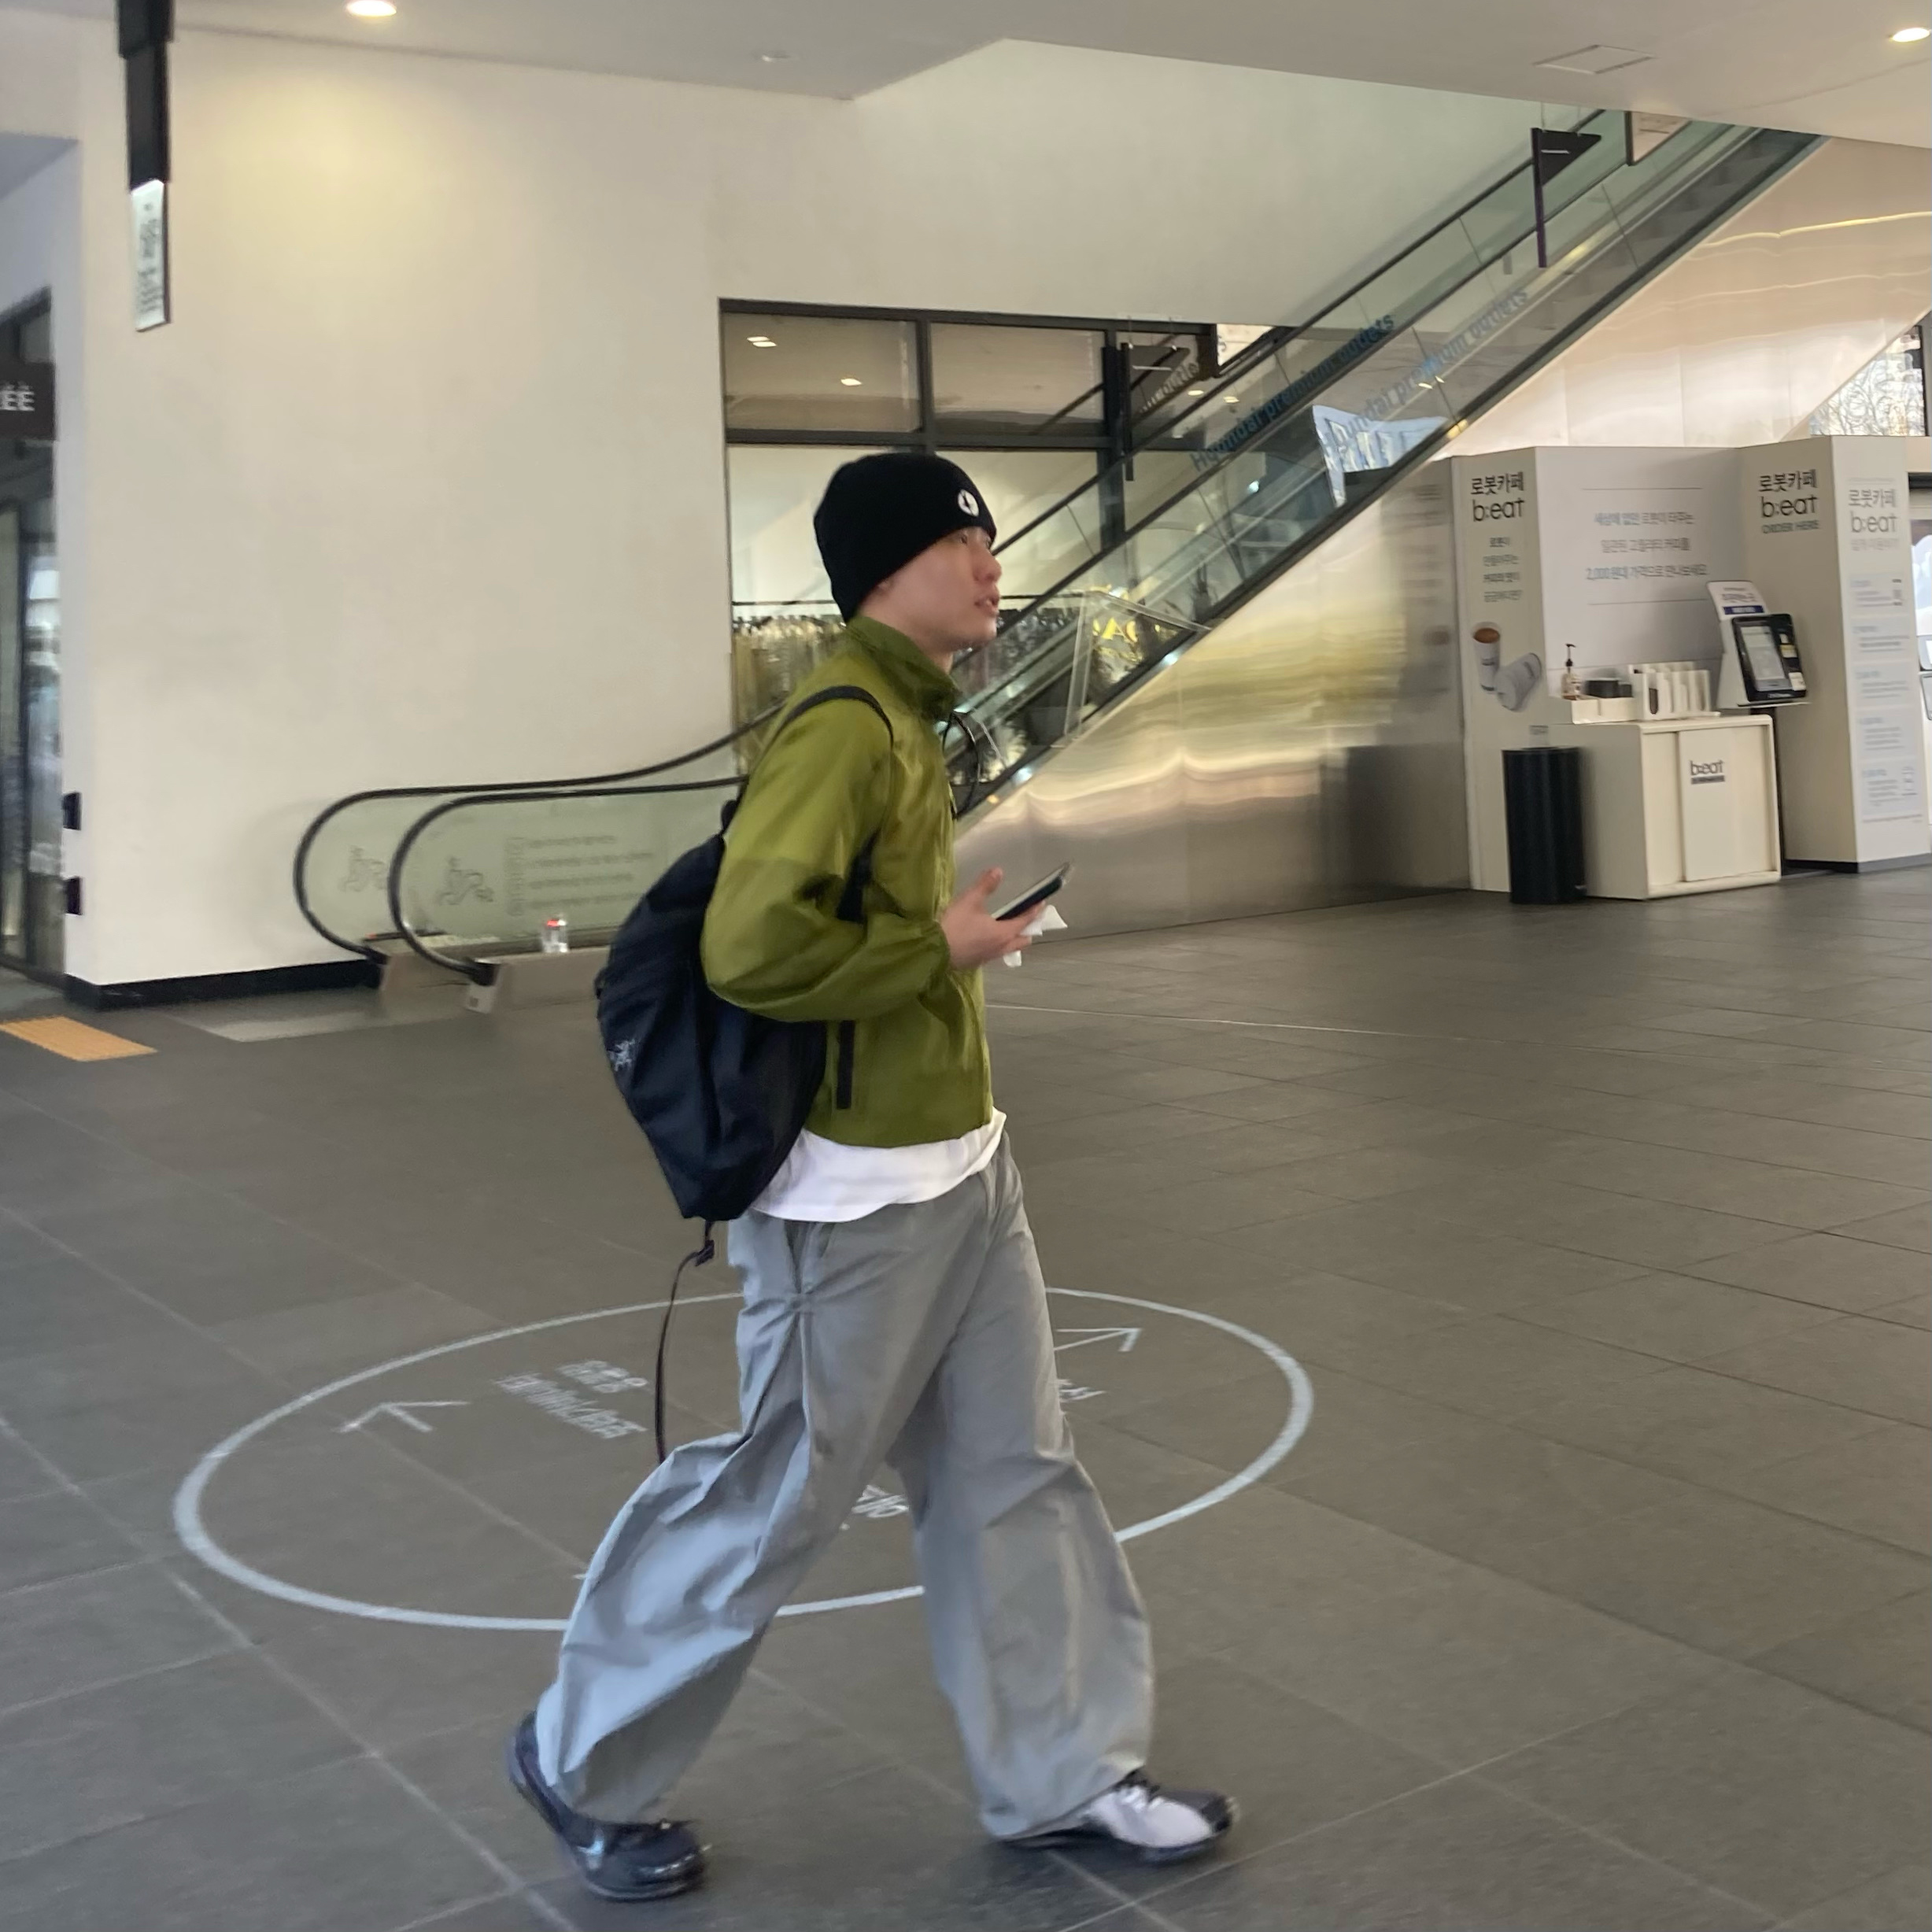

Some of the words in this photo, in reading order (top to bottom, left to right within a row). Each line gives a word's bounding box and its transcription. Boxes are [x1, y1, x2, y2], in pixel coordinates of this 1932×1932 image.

[1470, 471, 1525, 496] 로봇카페
[1757, 469, 1817, 493] 로봇카페
[1848, 488, 1897, 508] 로봇카페
